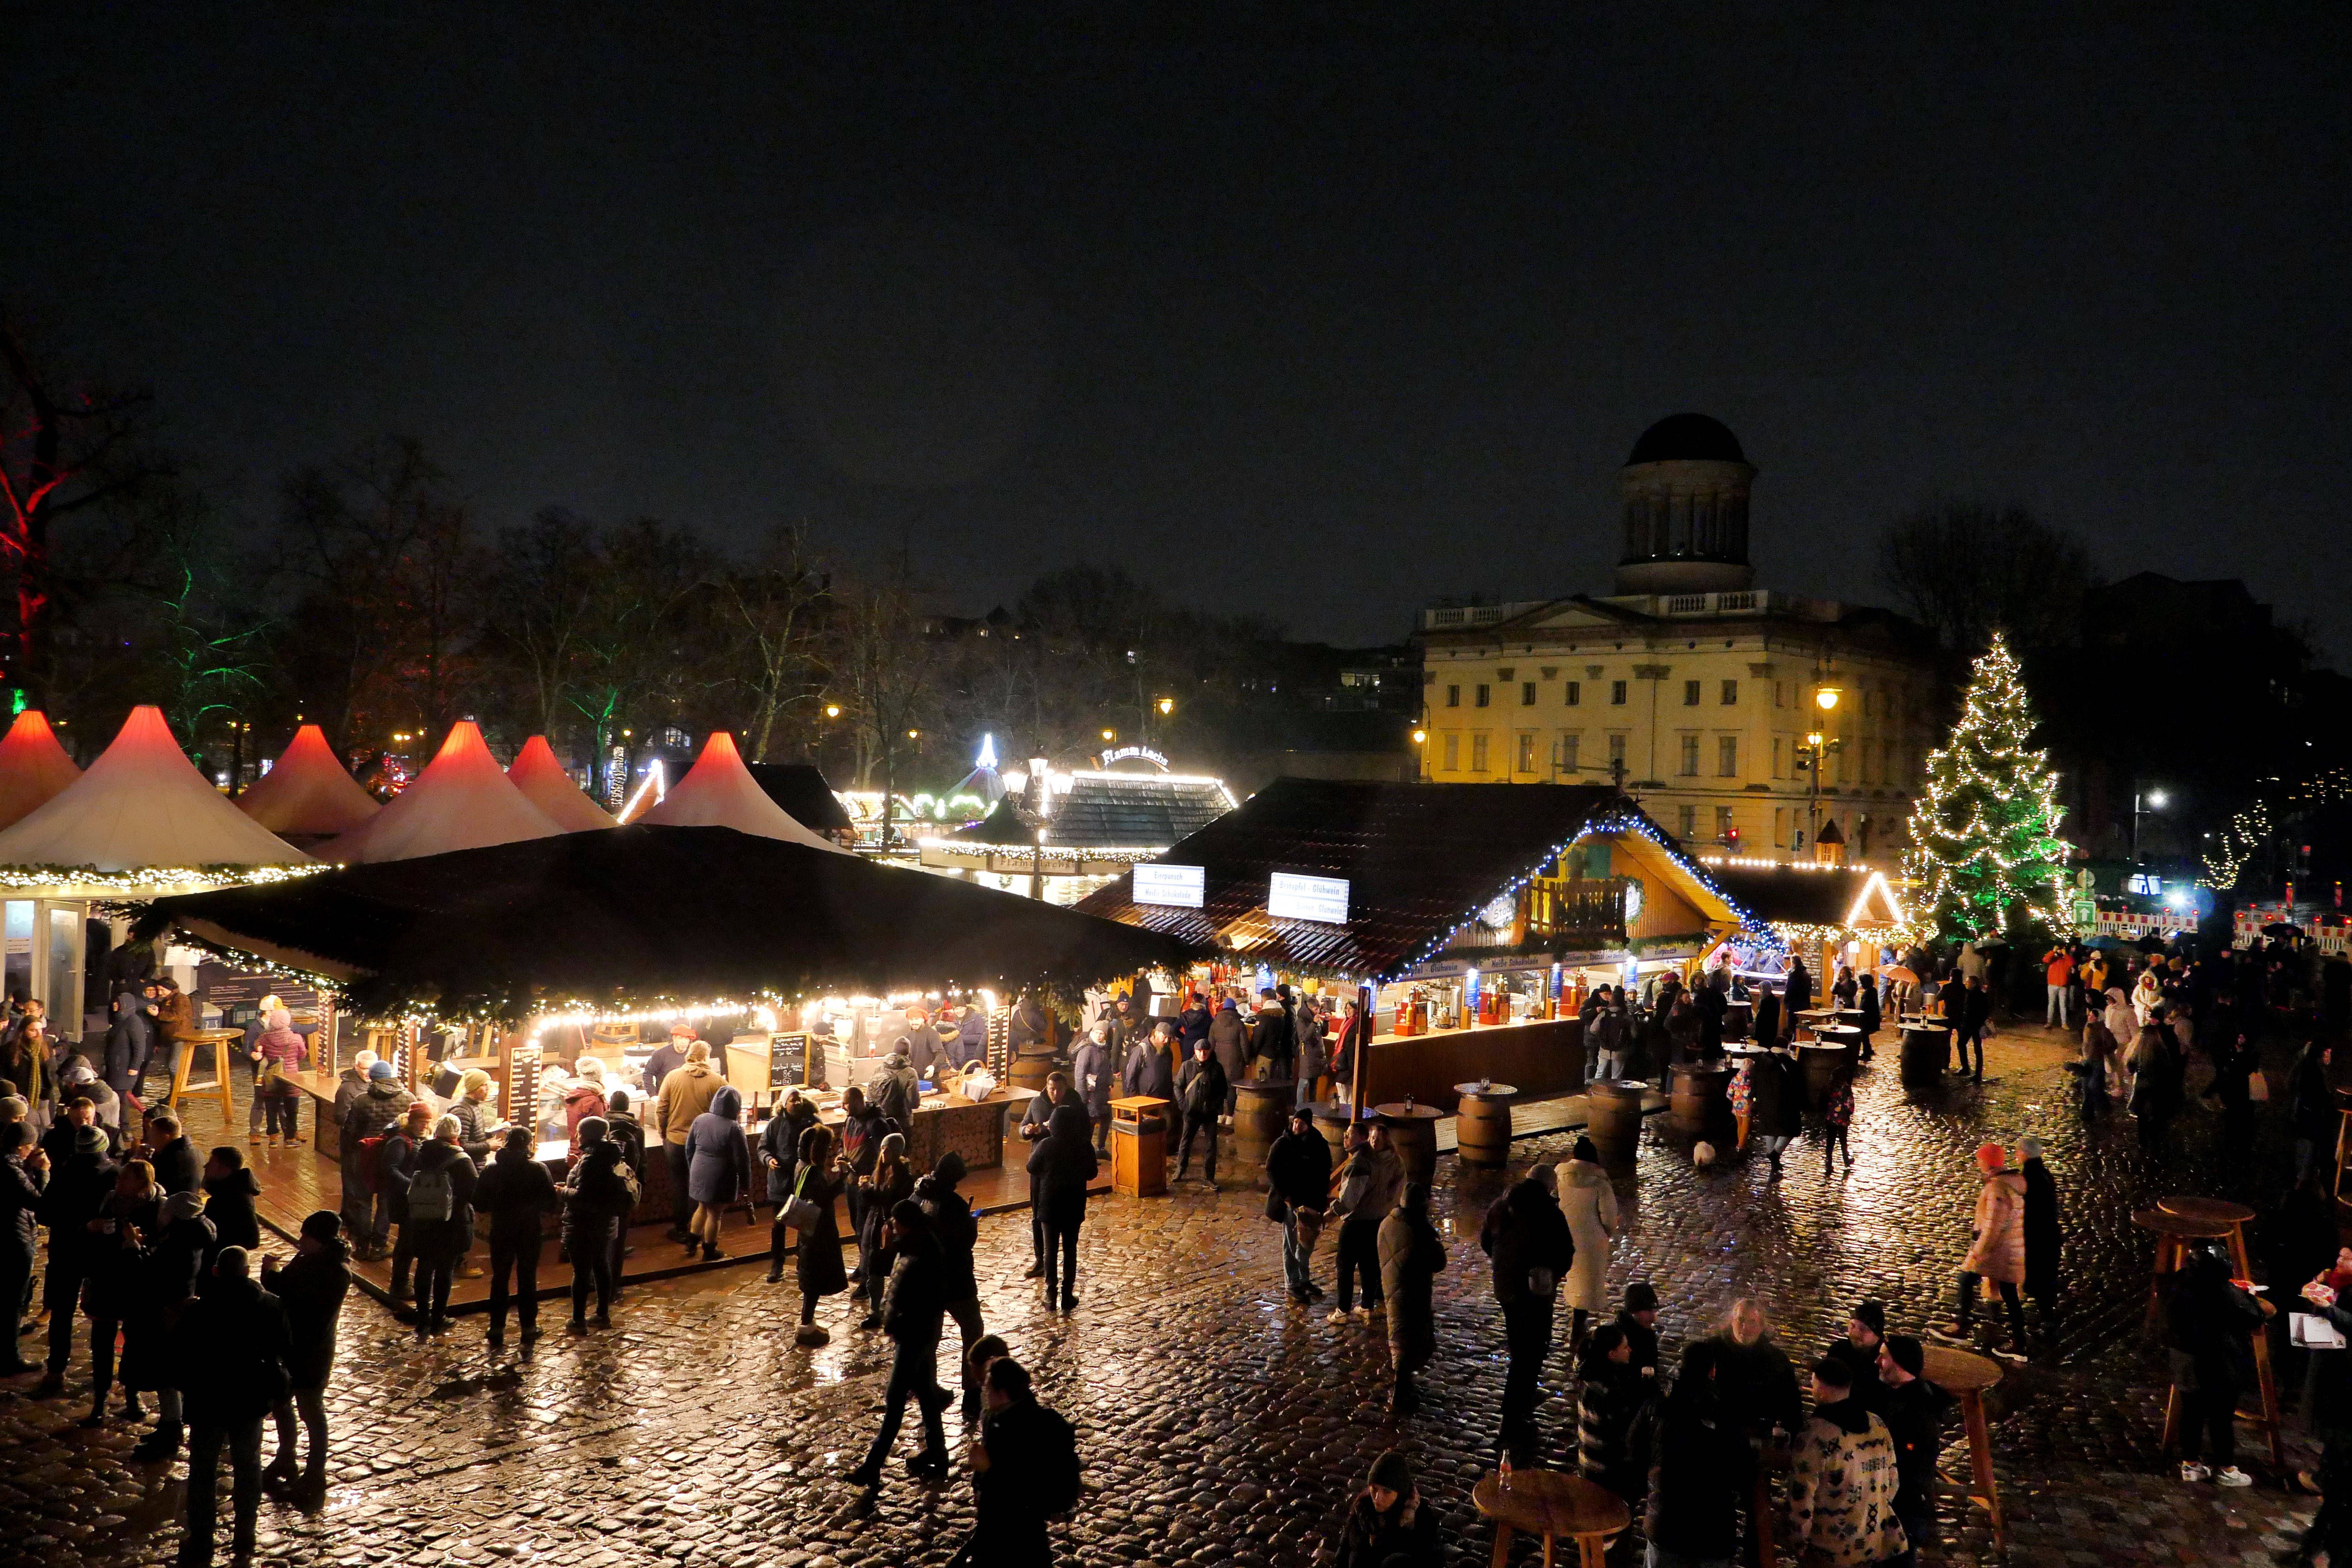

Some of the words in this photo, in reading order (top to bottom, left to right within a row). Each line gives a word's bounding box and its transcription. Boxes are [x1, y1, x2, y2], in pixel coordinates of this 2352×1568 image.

[1102, 747, 1139, 766] Flamm
[1141, 746, 1168, 766] Lachs
[1154, 871, 1182, 880] Eierpunsch
[1279, 880, 1306, 891] Bratapfel
[1312, 884, 1339, 895] Glühwein
[1162, 890, 1191, 899] Schokolade
[1494, 902, 1512, 919] Stadl
[1430, 962, 1457, 973] Glühwein
